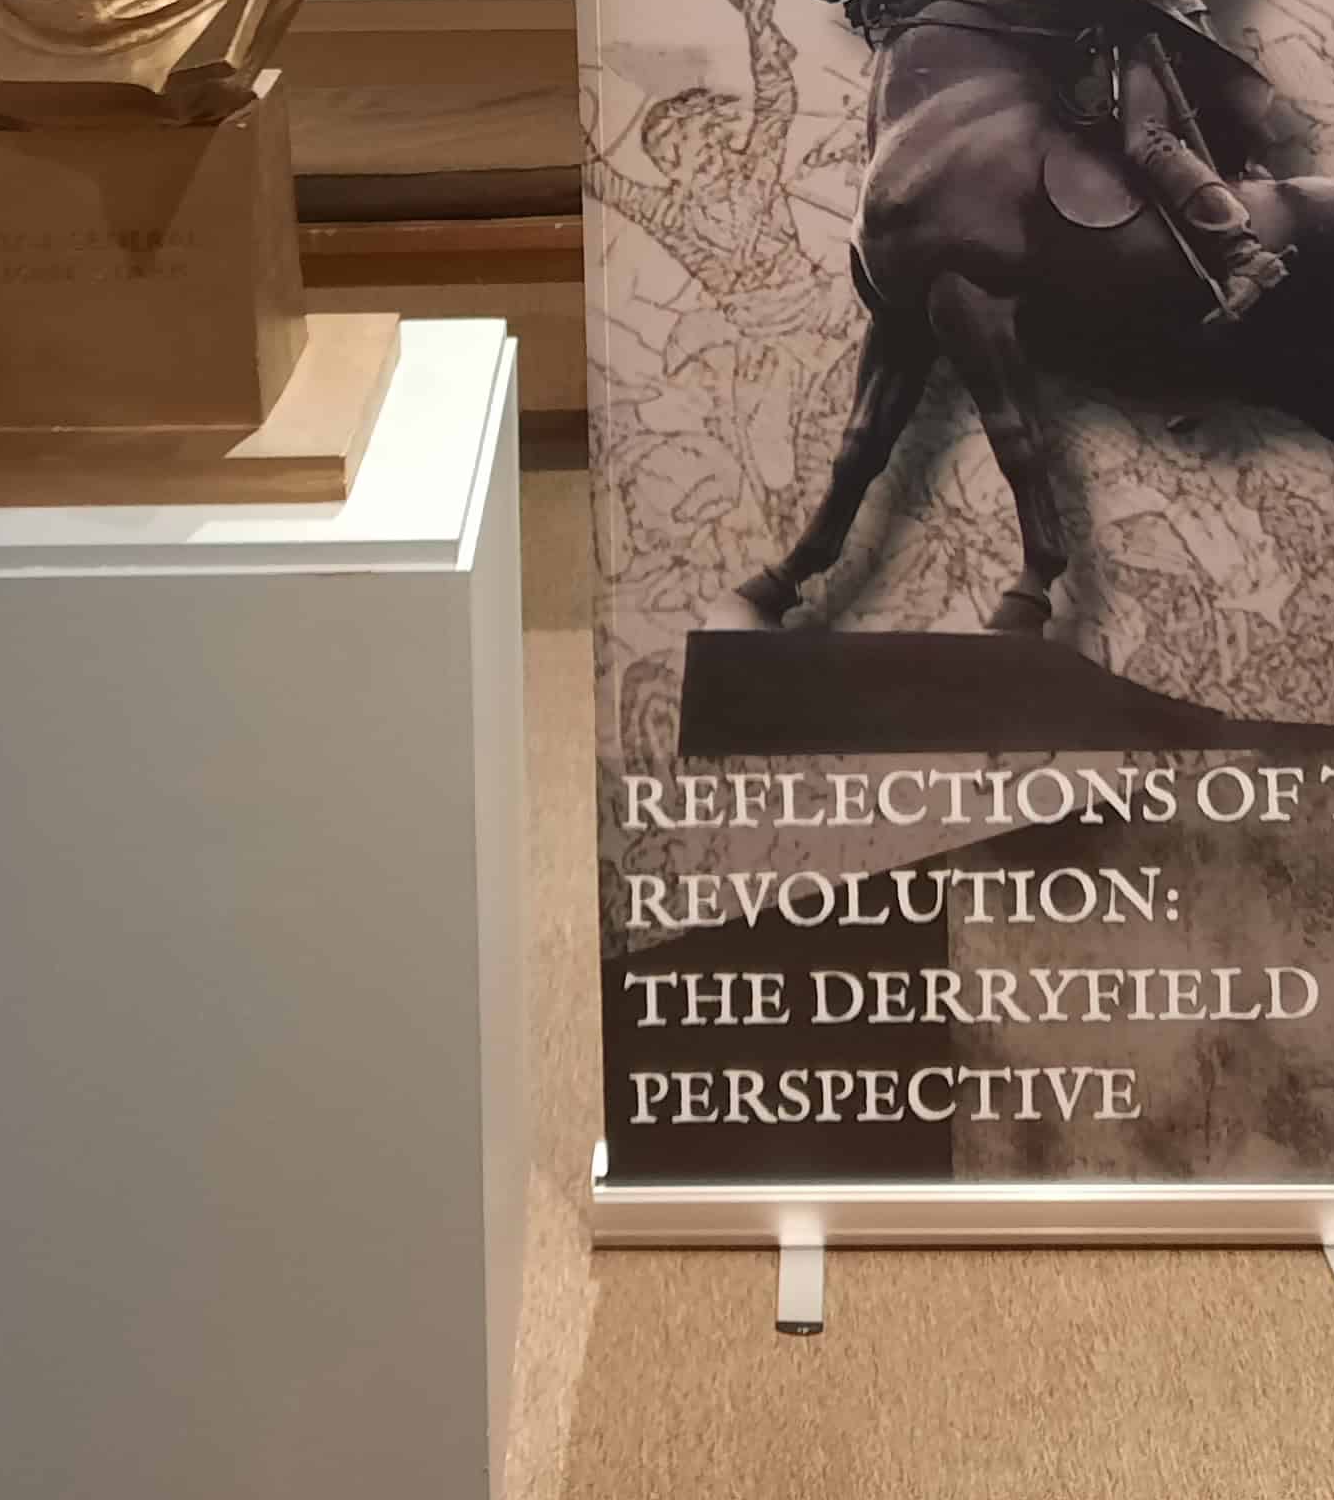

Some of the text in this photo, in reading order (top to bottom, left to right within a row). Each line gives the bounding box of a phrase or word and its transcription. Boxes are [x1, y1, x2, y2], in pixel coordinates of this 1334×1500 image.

[622, 766, 1177, 831] REFLECTIONS
[1196, 766, 1305, 823] OF
[624, 865, 1181, 930] REVOLUTION:
[624, 966, 1320, 1027] THE DERRYFIELD
[629, 1066, 1142, 1125] PERSPECTIVE
